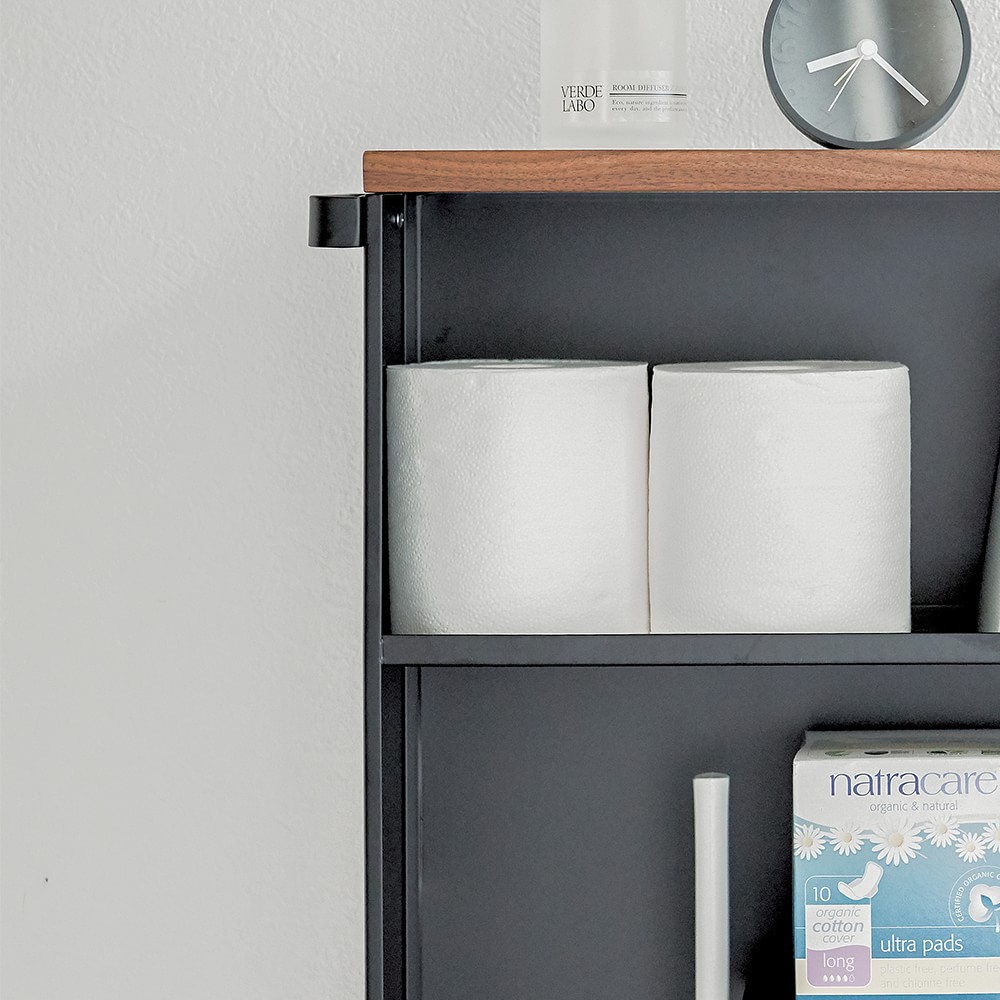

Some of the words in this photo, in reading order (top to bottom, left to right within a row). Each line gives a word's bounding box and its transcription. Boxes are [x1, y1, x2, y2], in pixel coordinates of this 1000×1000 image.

[561, 85, 603, 98] VERDE
[562, 99, 595, 112] LABO
[830, 769, 998, 796] natracare
[870, 802, 908, 814] organic
[911, 801, 919, 811] &
[923, 800, 958, 811] natural
[813, 886, 831, 902] 10
[954, 887, 965, 922] CERTIFIED
[963, 871, 995, 887] ORGANIC
[816, 907, 861, 920] organic
[813, 919, 865, 933] cotton
[822, 934, 855, 944] cover
[880, 935, 916, 952] ultra
[923, 934, 963, 956] pads
[823, 953, 855, 971] long
[880, 963, 911, 976] plastic
[940, 963, 983, 975] perfume
